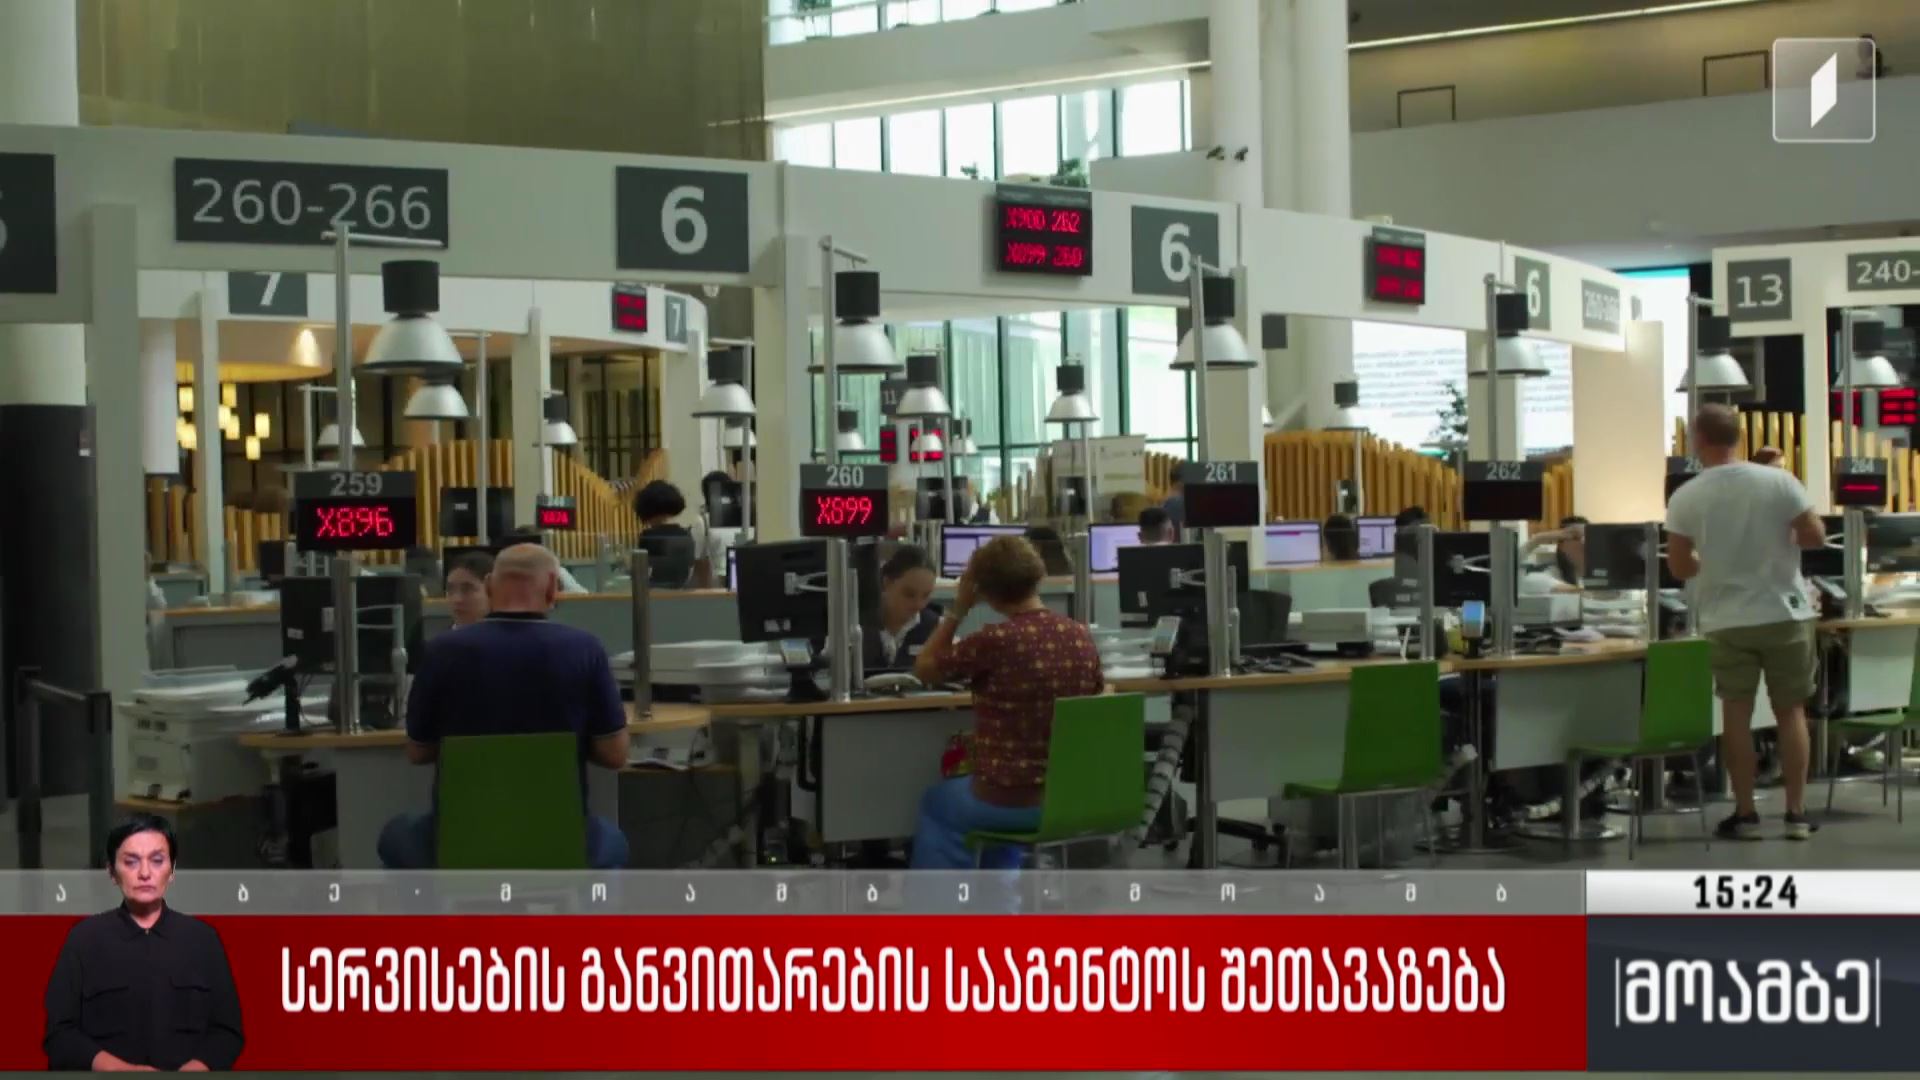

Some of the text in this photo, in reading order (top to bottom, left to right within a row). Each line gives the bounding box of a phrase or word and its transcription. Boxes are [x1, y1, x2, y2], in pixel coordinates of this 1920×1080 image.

[190, 176, 434, 231] 260-266
[660, 185, 709, 255] 6
[1159, 222, 1191, 283] 6
[1526, 269, 1542, 317] 6
[1735, 274, 1784, 308] 13
[669, 302, 681, 337] 7
[329, 472, 383, 497] 259
[825, 465, 865, 488] 260
[1204, 463, 1239, 483] 261
[1486, 461, 1522, 480] 262
[315, 506, 395, 538] X896
